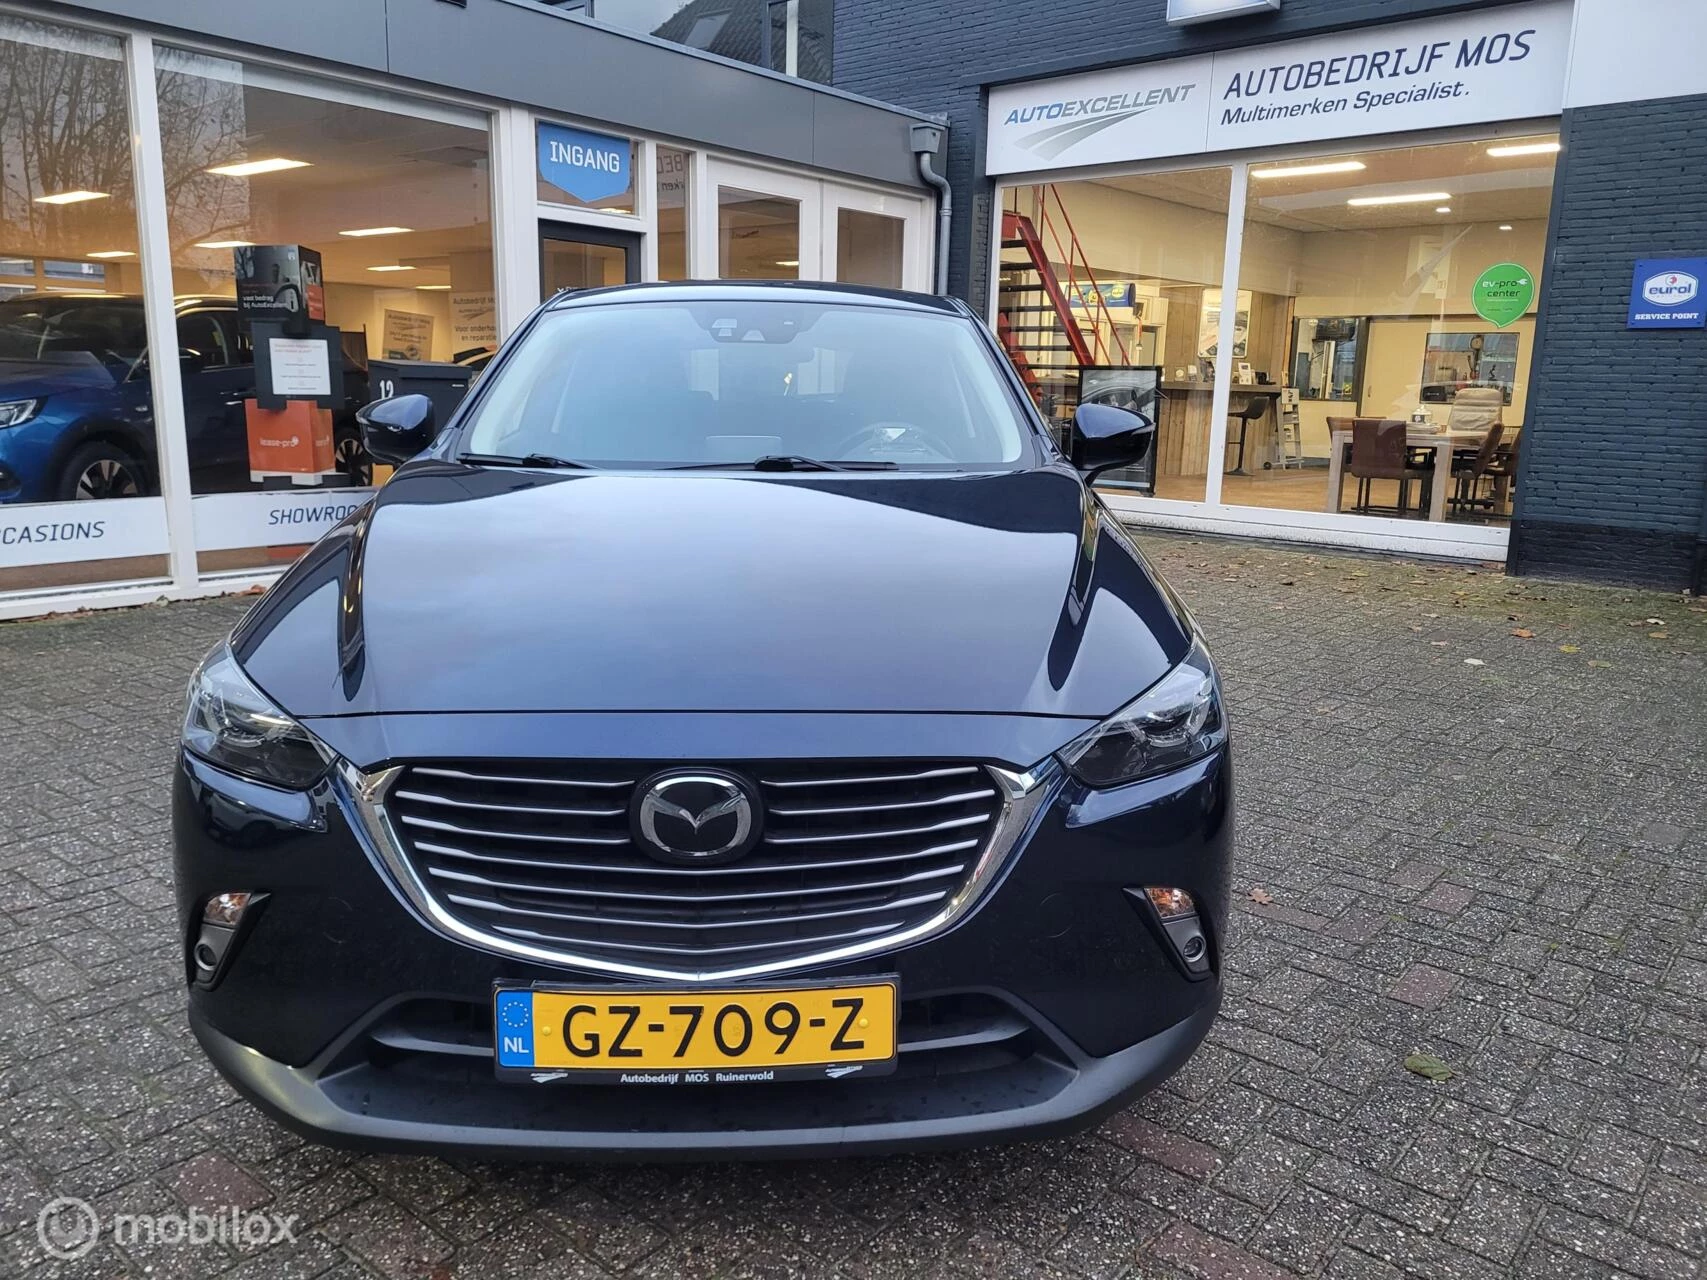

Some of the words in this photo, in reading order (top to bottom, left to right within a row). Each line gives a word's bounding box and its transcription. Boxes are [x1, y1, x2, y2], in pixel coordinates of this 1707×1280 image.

[1223, 42, 1450, 100] AUTOBEDRIJF
[1455, 29, 1536, 69] MOS
[1004, 84, 1196, 125] AUTOEXCELLENT
[1220, 96, 1348, 126] Multimerken
[1353, 81, 1470, 113] Specialist.
[550, 141, 620, 173] INGANG
[1649, 283, 1692, 295] eurol
[1634, 313, 1671, 321] SERVICE
[1672, 312, 1699, 320] POINT
[0, 521, 105, 544] CASIONS
[562, 997, 865, 1058] GZ-709-Z
[504, 1036, 529, 1054] NL
[620, 1073, 679, 1084] Autobedrijf
[684, 1073, 710, 1083] MOS
[715, 1071, 774, 1082] Ruinerwold
